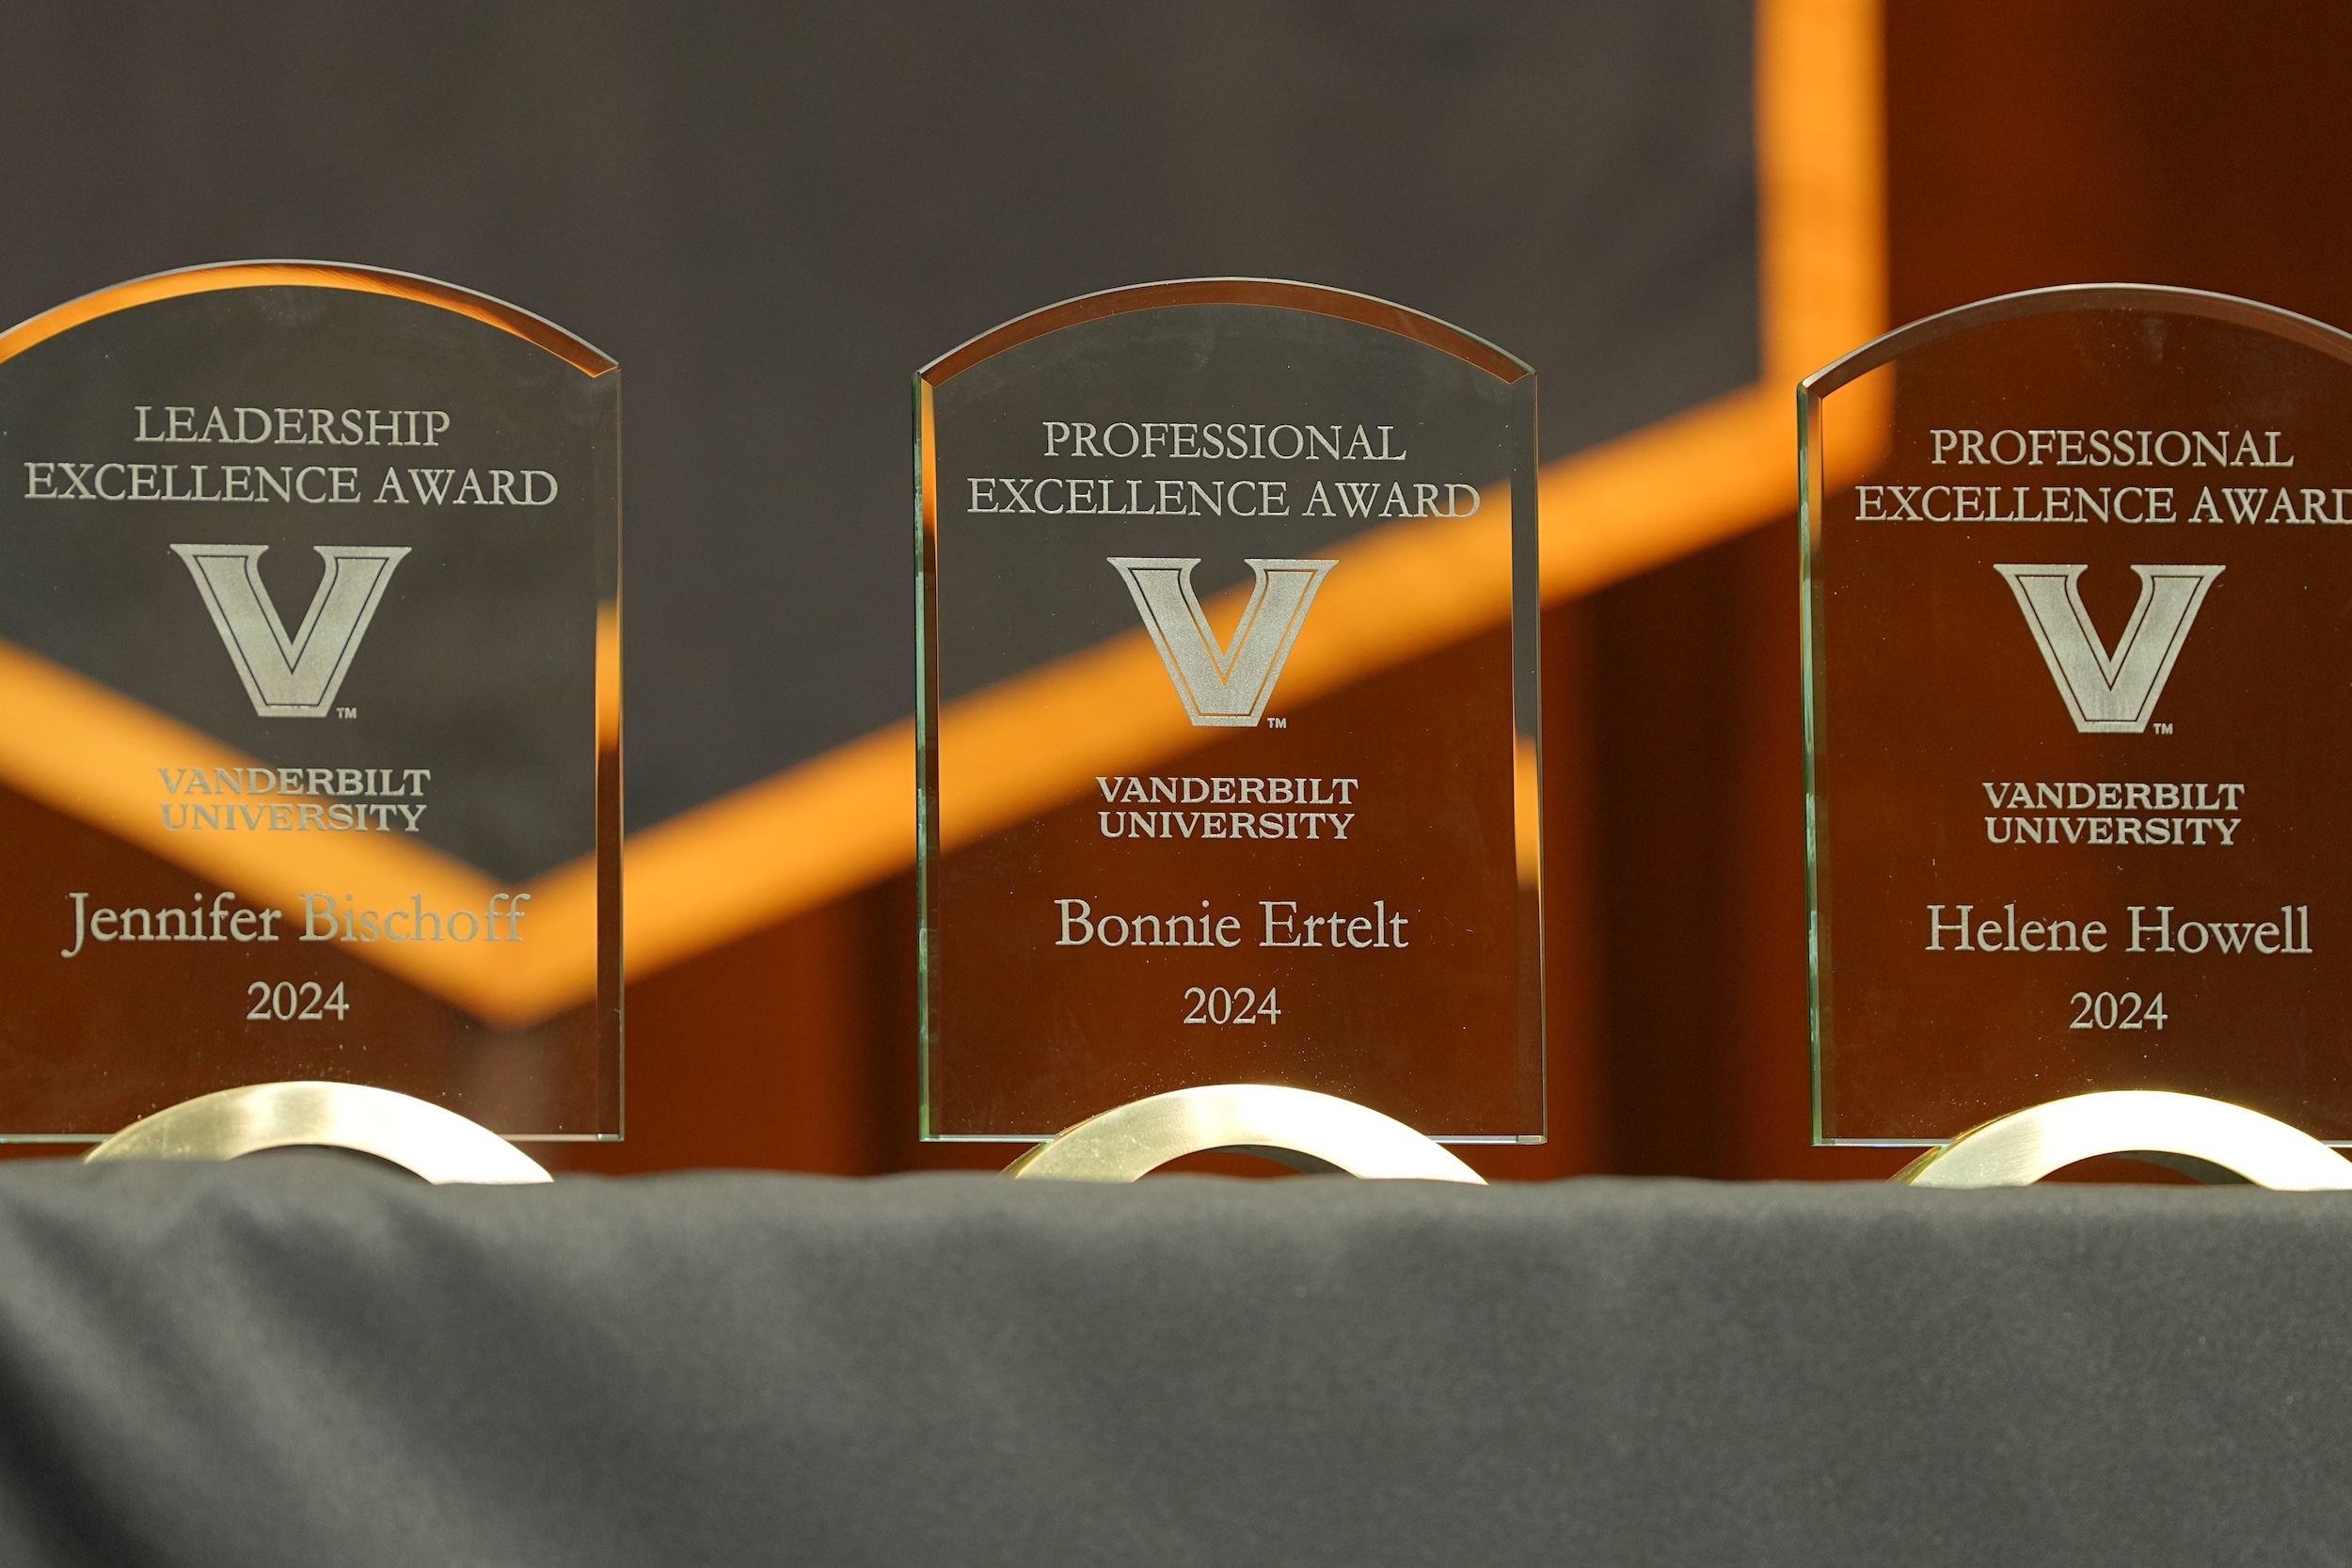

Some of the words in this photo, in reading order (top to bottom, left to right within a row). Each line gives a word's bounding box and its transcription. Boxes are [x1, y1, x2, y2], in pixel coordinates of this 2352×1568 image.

[135, 406, 450, 447] LEADERSHIP
[1042, 421, 1406, 462] PROFESSIONAL
[1931, 429, 2295, 467] PROFESSIONAL
[24, 462, 361, 504] EXCELLENCE
[373, 467, 558, 505] AWARD
[967, 478, 1290, 516] EXCELLENCE
[1302, 482, 1481, 518] AWARD
[1855, 485, 2177, 523] EXCELLENCE
[169, 543, 412, 718] V
[336, 707, 357, 719] TM
[1106, 557, 1339, 728] V
[1267, 718, 1287, 729] TM
[1994, 563, 2226, 734] V
[2153, 723, 2173, 735] TM
[158, 768, 431, 797] VANDERBILT
[1096, 776, 1359, 805] VANDERBILT
[1982, 783, 2246, 811] VANDERBILT
[161, 803, 427, 832] UNIVERSITY
[1098, 812, 1356, 840] UNIVERSITY
[1985, 817, 2242, 846] UNIVERSITY
[60, 892, 281, 958] Jennifer
[298, 893, 532, 942] Bischoff
[1054, 898, 1241, 948] Bonnie
[1259, 901, 1409, 949] Ertelt
[1925, 904, 2108, 953] Helene
[2126, 905, 2313, 955] Howell
[246, 981, 349, 1021] 2024
[1184, 987, 1281, 1025] 2024
[2070, 991, 2169, 1030] 2024
